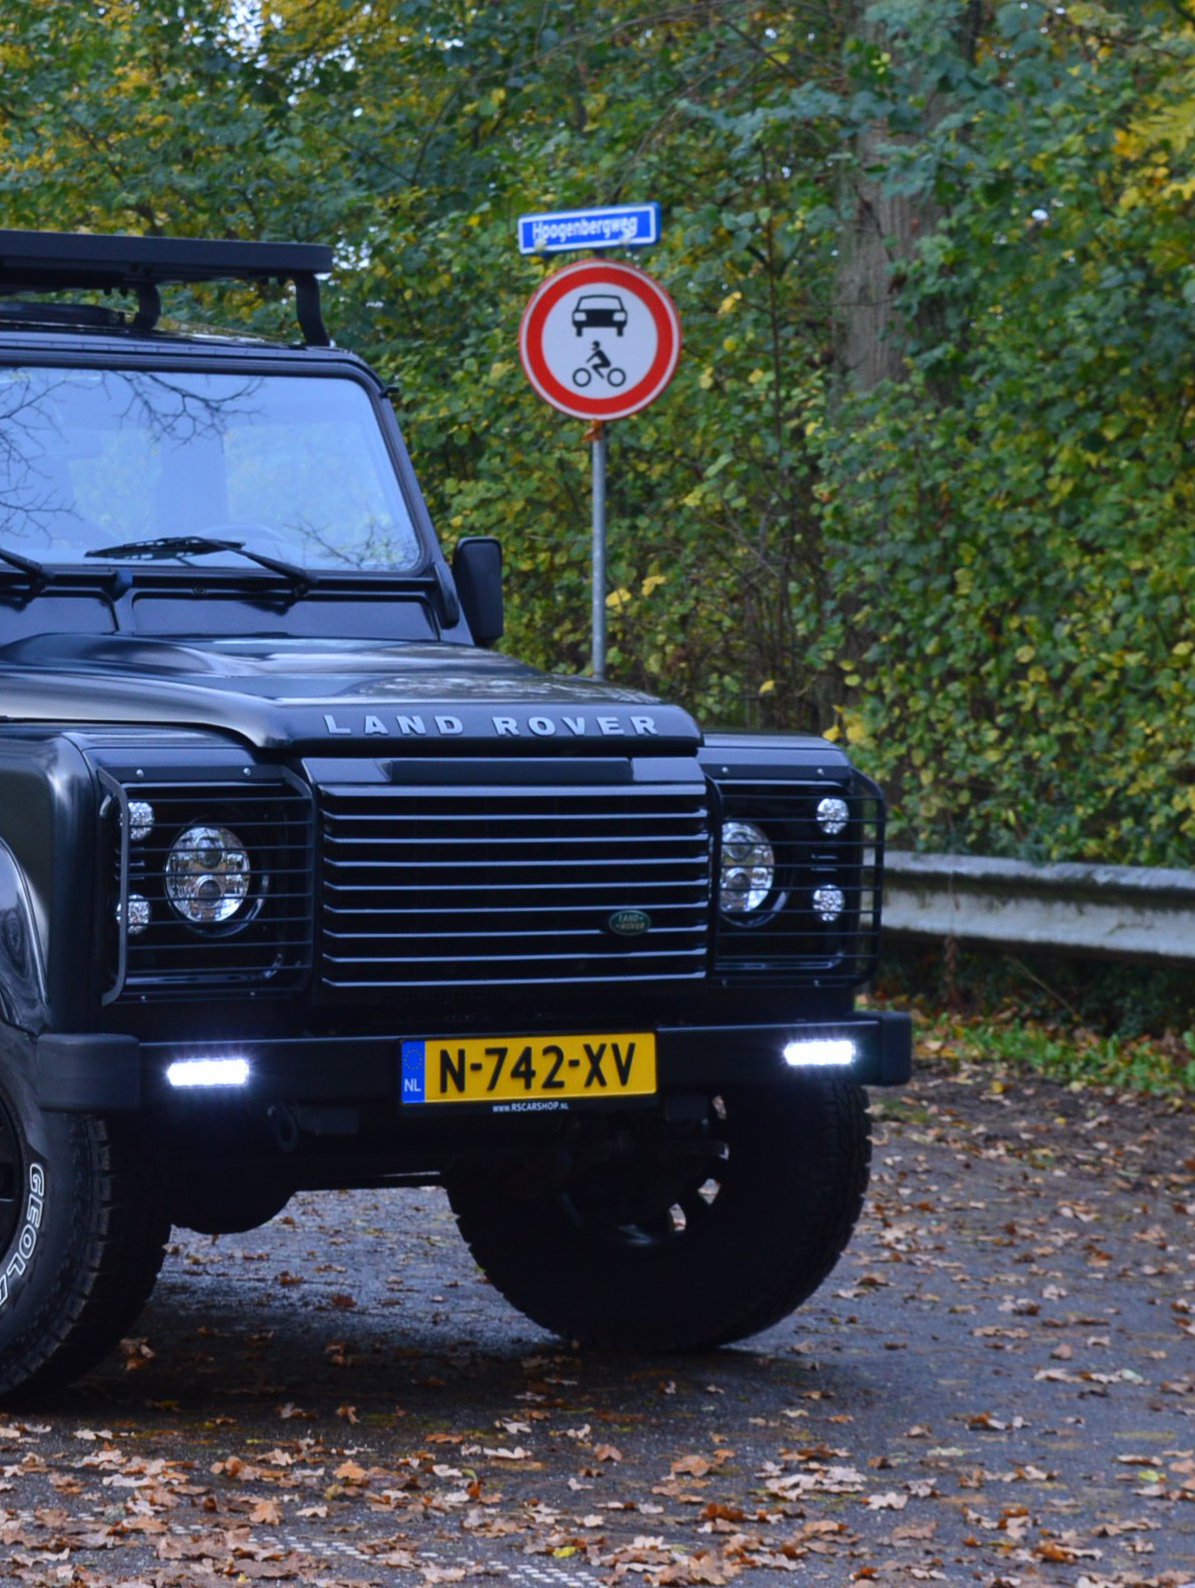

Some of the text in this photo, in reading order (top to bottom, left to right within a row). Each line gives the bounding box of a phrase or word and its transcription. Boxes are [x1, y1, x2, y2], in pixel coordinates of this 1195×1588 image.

[532, 215, 638, 242] Hoogenbergweg
[324, 714, 658, 736] LAND ROVER
[439, 1042, 637, 1094] N-742-XV
[404, 1079, 421, 1093] NL
